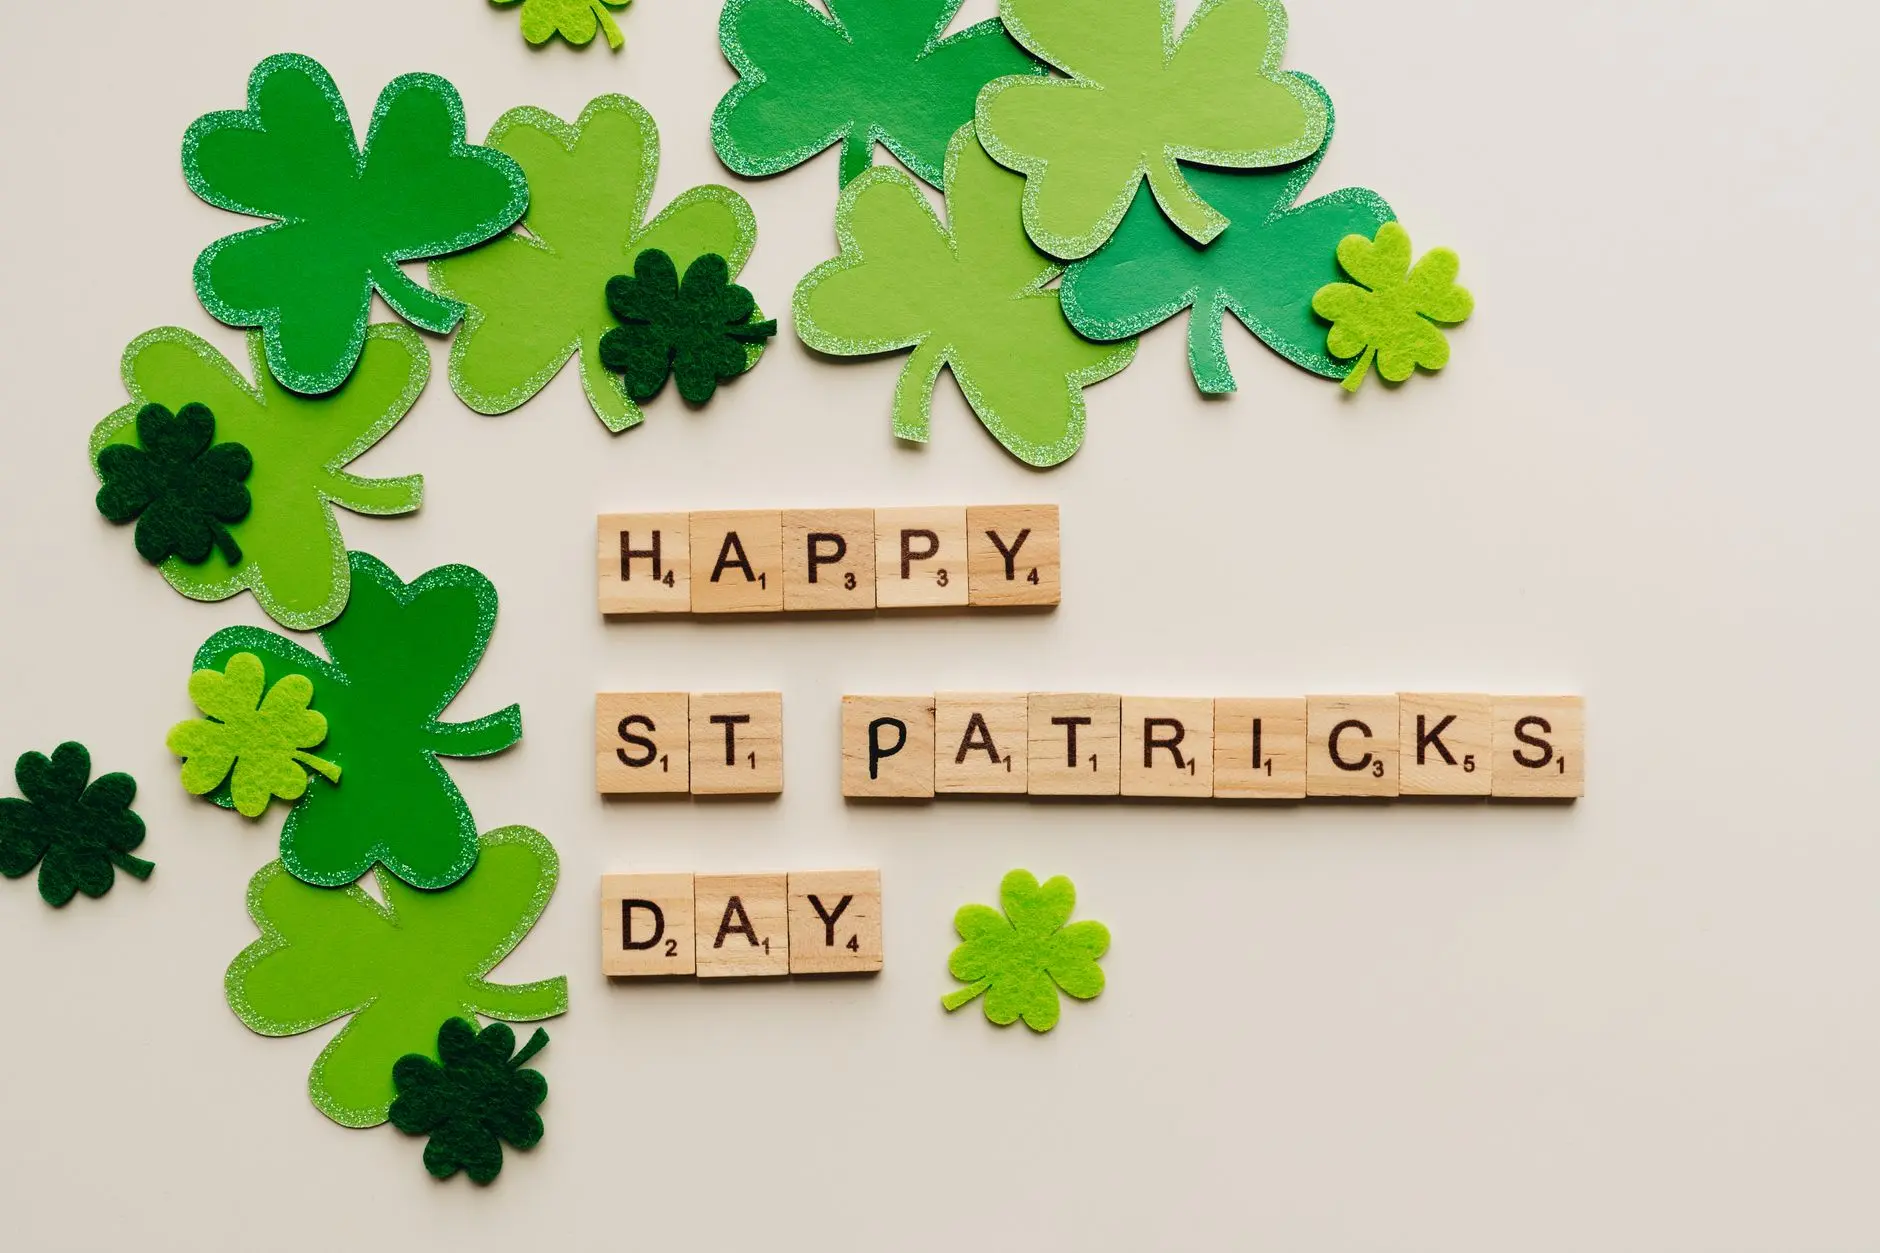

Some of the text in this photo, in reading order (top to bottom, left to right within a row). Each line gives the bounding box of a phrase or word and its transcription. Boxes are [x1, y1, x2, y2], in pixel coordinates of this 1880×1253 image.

[619, 528, 1031, 584] HAPPY
[615, 714, 1554, 780] ST PATRICKS
[621, 894, 854, 951] DAY
